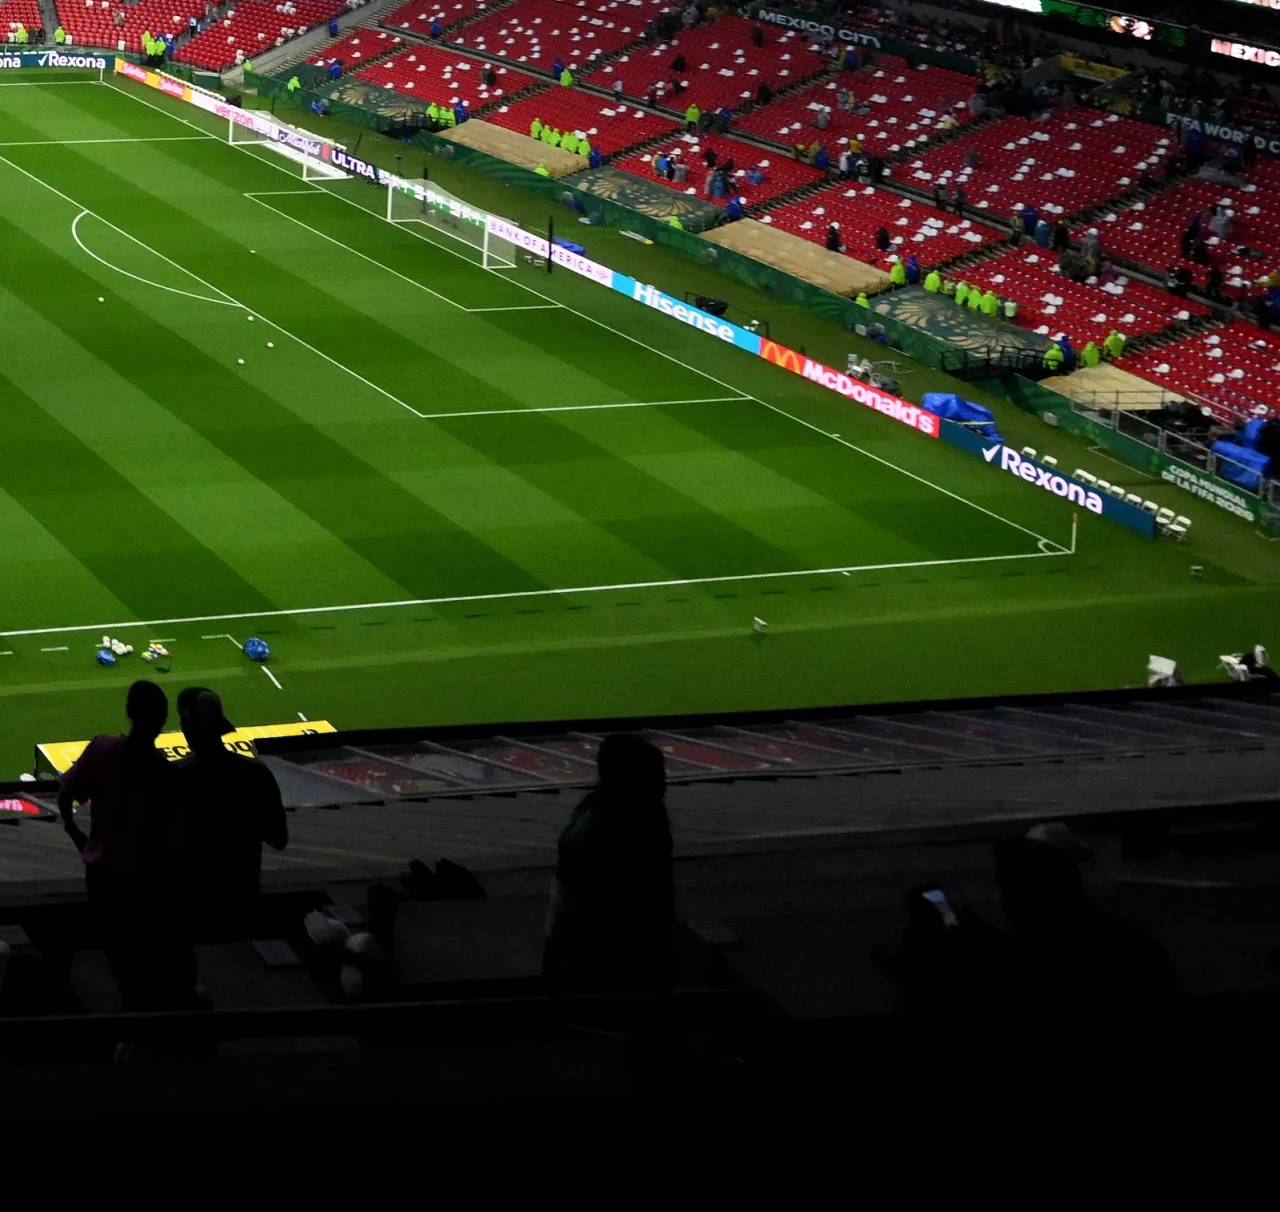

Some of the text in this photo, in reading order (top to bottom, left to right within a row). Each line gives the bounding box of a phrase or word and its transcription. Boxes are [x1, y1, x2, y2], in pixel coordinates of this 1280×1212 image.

[758, 9, 835, 37] MEXICO
[48, 53, 105, 69] Rexona
[214, 103, 254, 128] verizon
[1203, 122, 1267, 149] WORD
[331, 148, 375, 179] ULTRA
[491, 220, 594, 275] BANK OF AMERICA
[634, 279, 735, 344] Hisense
[803, 359, 935, 434] McDonald's
[1001, 446, 1103, 515] Rexona
[1169, 465, 1198, 484] COPA
[1176, 477, 1191, 491] LA
